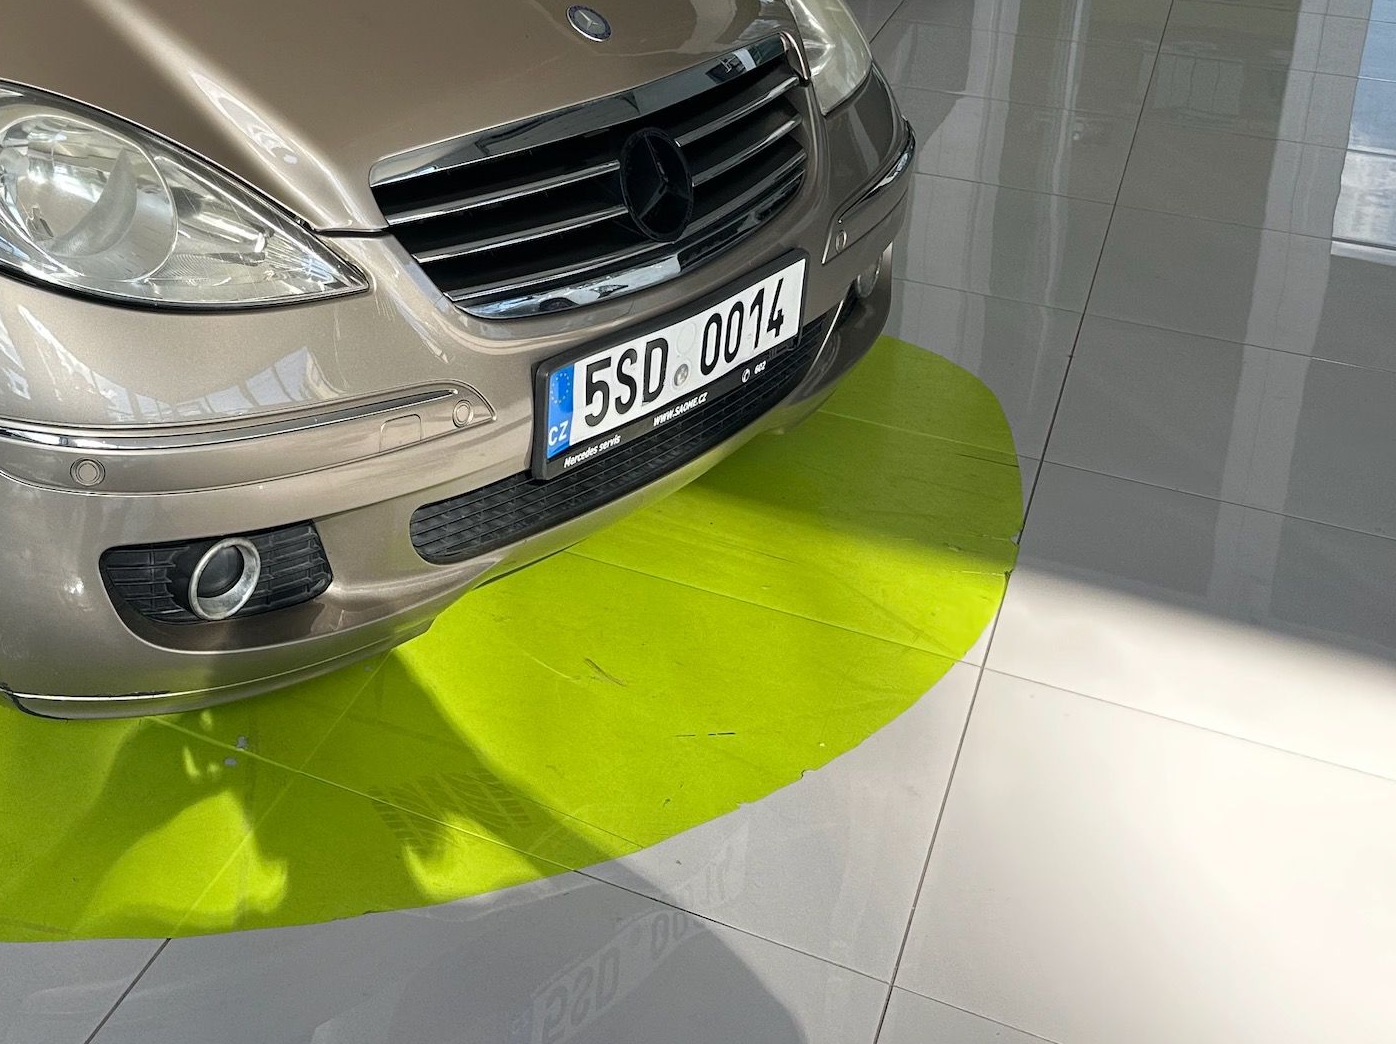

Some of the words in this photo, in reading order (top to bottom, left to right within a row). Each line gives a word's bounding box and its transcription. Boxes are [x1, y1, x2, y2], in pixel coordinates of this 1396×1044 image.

[584, 337, 669, 427] 5SD
[700, 277, 785, 376] 0014
[548, 420, 568, 446] CZ
[564, 444, 599, 468] Mercedes
[599, 434, 621, 452] servis
